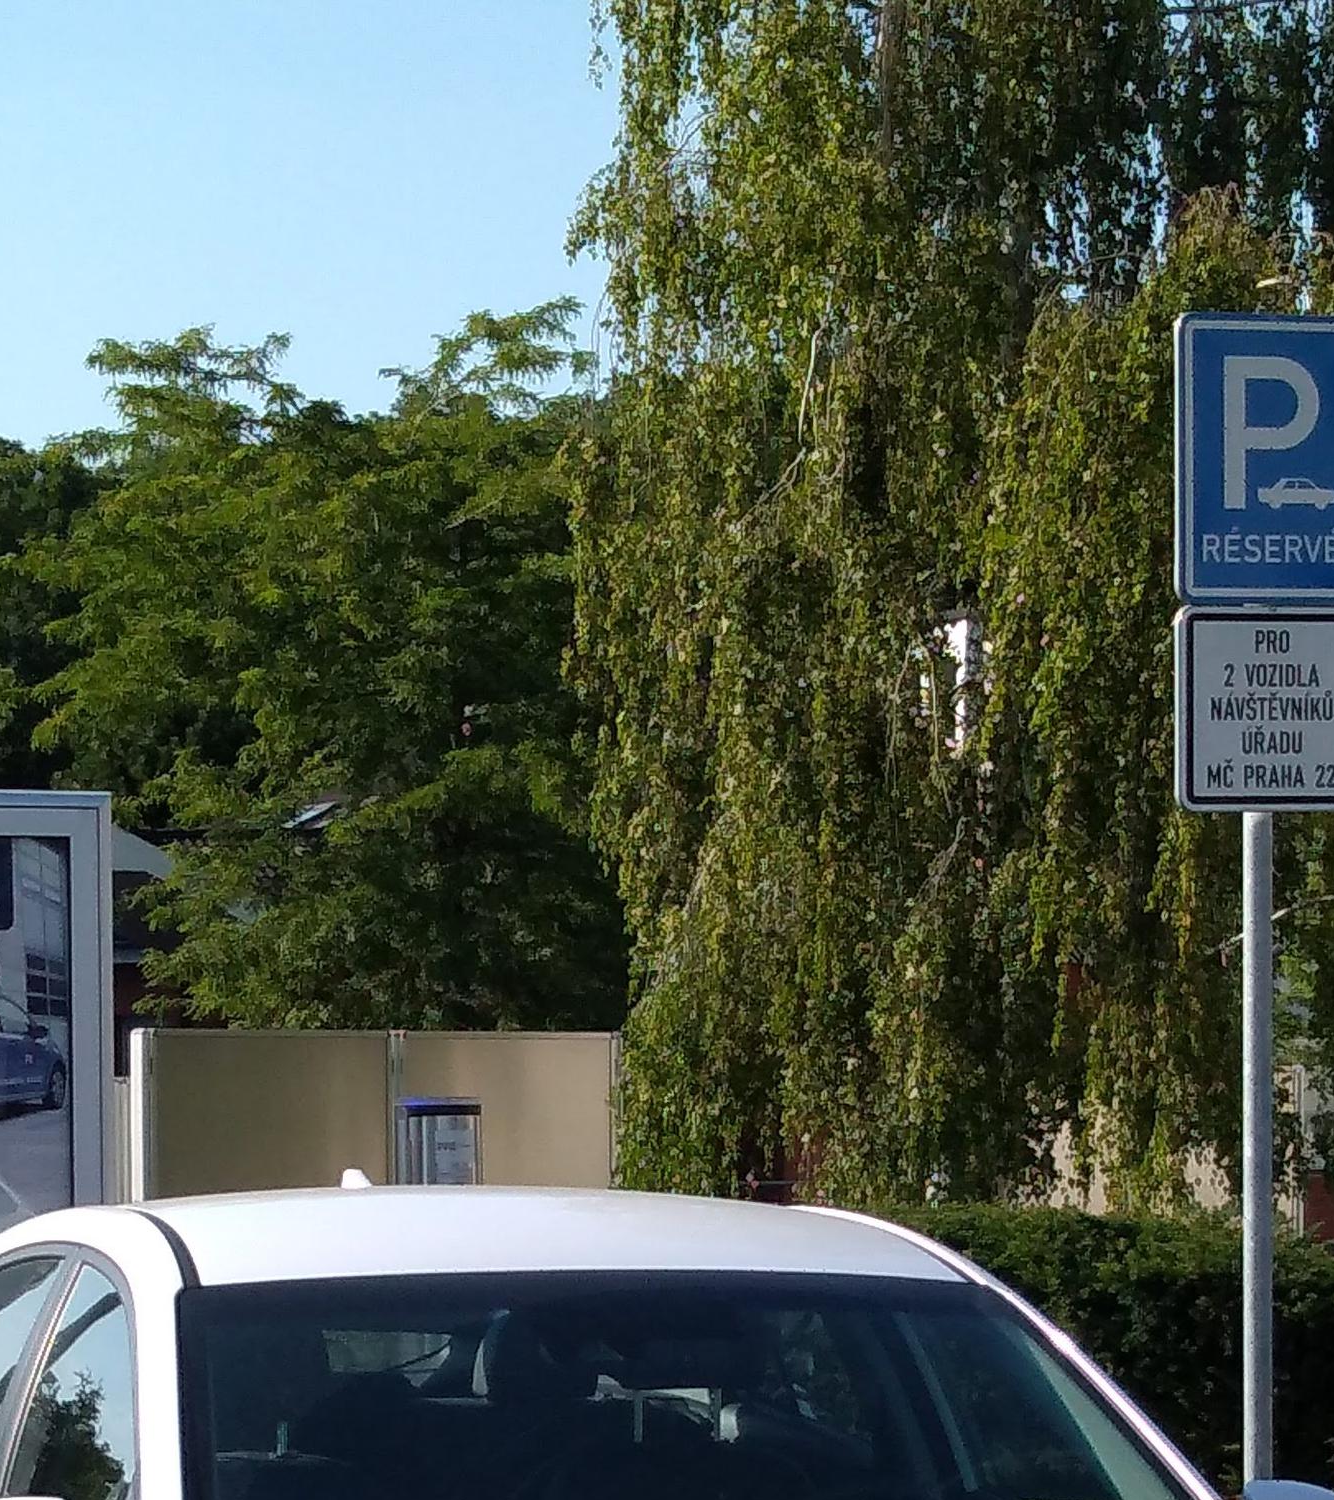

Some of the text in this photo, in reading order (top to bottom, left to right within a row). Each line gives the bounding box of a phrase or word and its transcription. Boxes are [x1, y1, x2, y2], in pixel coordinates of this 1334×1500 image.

[1223, 355, 1320, 510] P
[1254, 630, 1291, 653] PRO
[1224, 663, 1320, 688] 2 VOZIDLA
[1210, 690, 1334, 722] NÁVŠTĚVNÍKŮ
[1241, 725, 1303, 755] ÚŘADU
[1207, 760, 1234, 789] MČ
[1243, 765, 1304, 788] PRAHA
